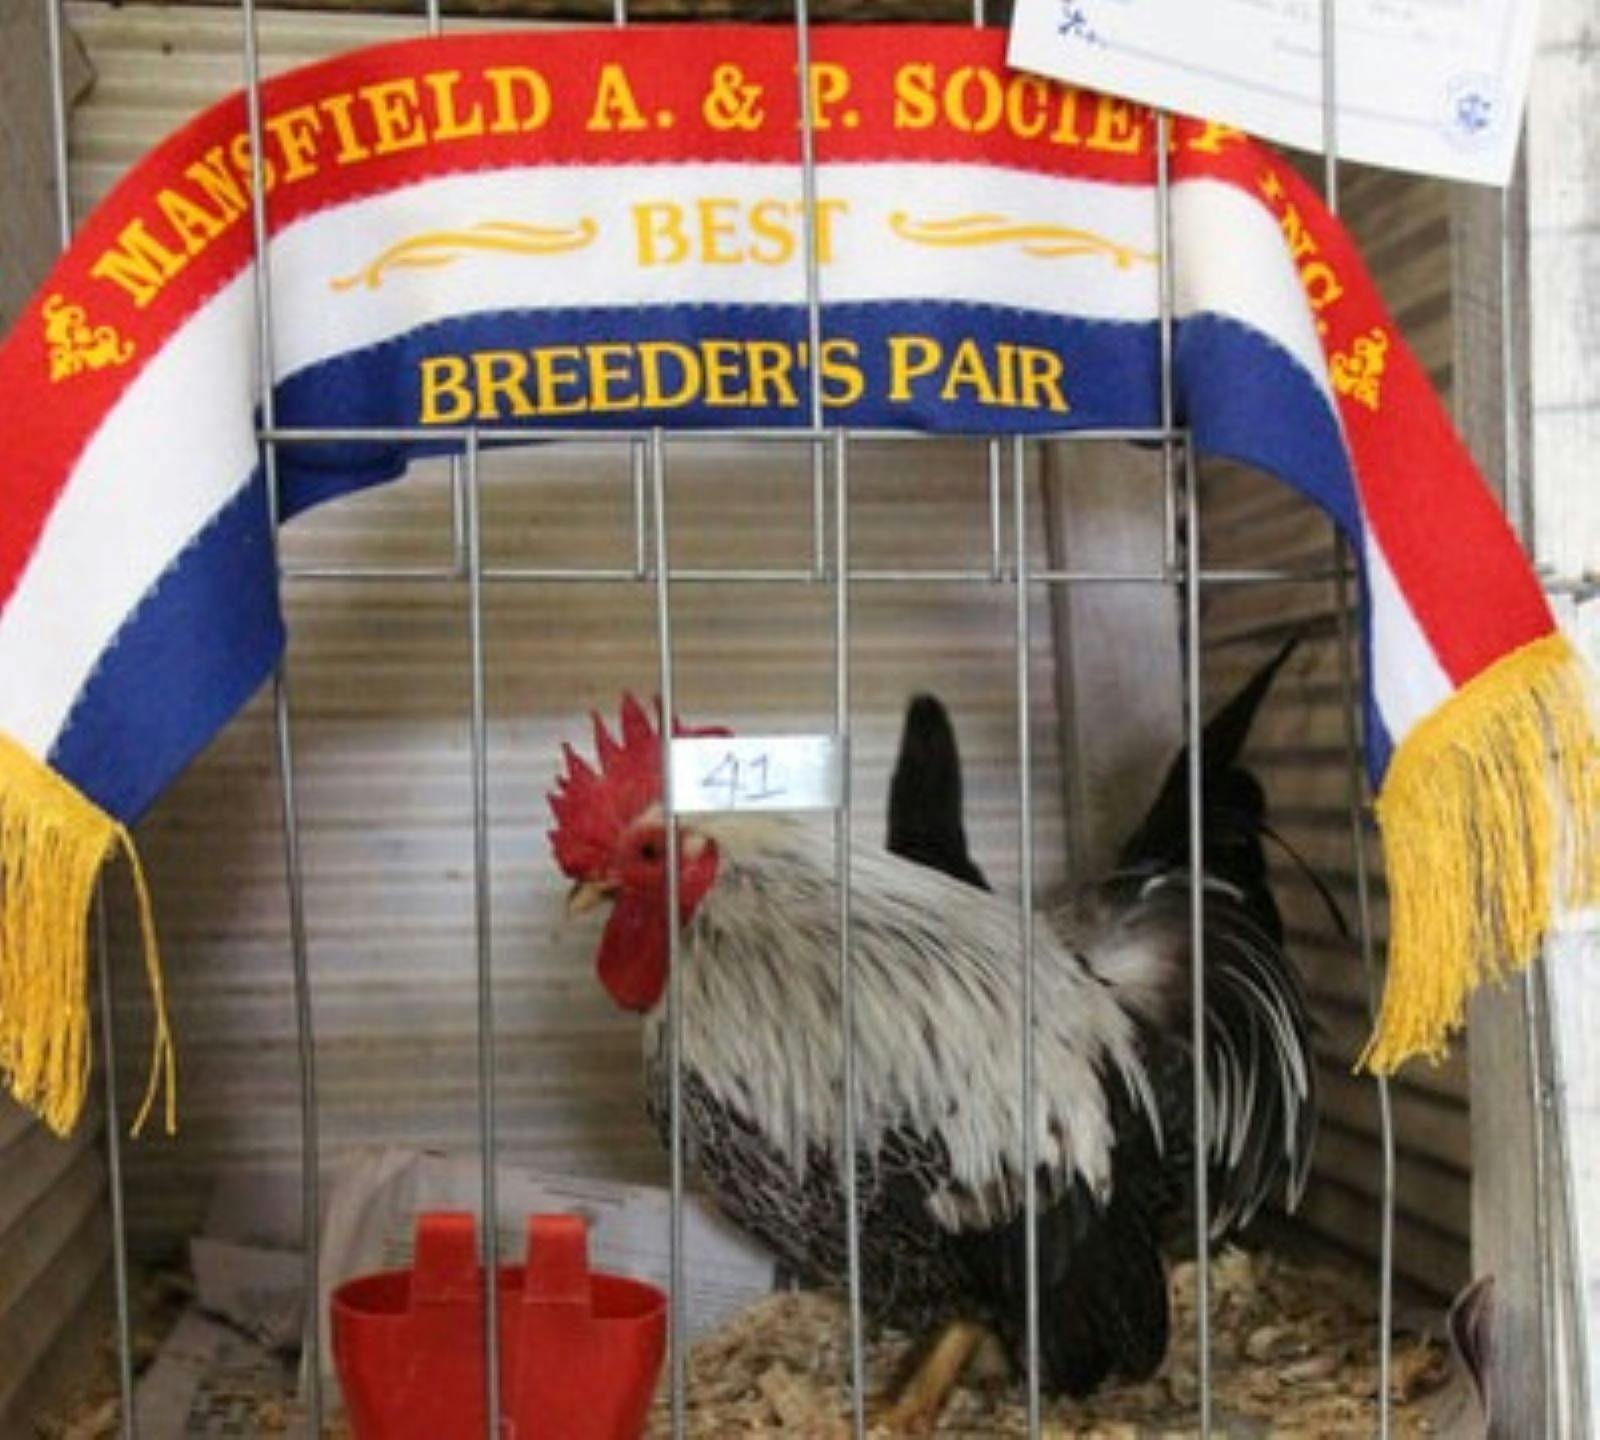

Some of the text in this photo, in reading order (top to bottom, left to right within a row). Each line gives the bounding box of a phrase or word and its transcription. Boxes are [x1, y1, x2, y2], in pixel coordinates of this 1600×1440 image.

[91, 67, 551, 308] MANSFIELD
[587, 65, 674, 130] A.
[703, 65, 764, 130] &
[797, 64, 859, 128] P.
[894, 65, 1247, 155] SOCIE
[631, 199, 848, 267] BEST
[420, 337, 1069, 424] BREEDER'S PAIR
[702, 752, 787, 808] 41
